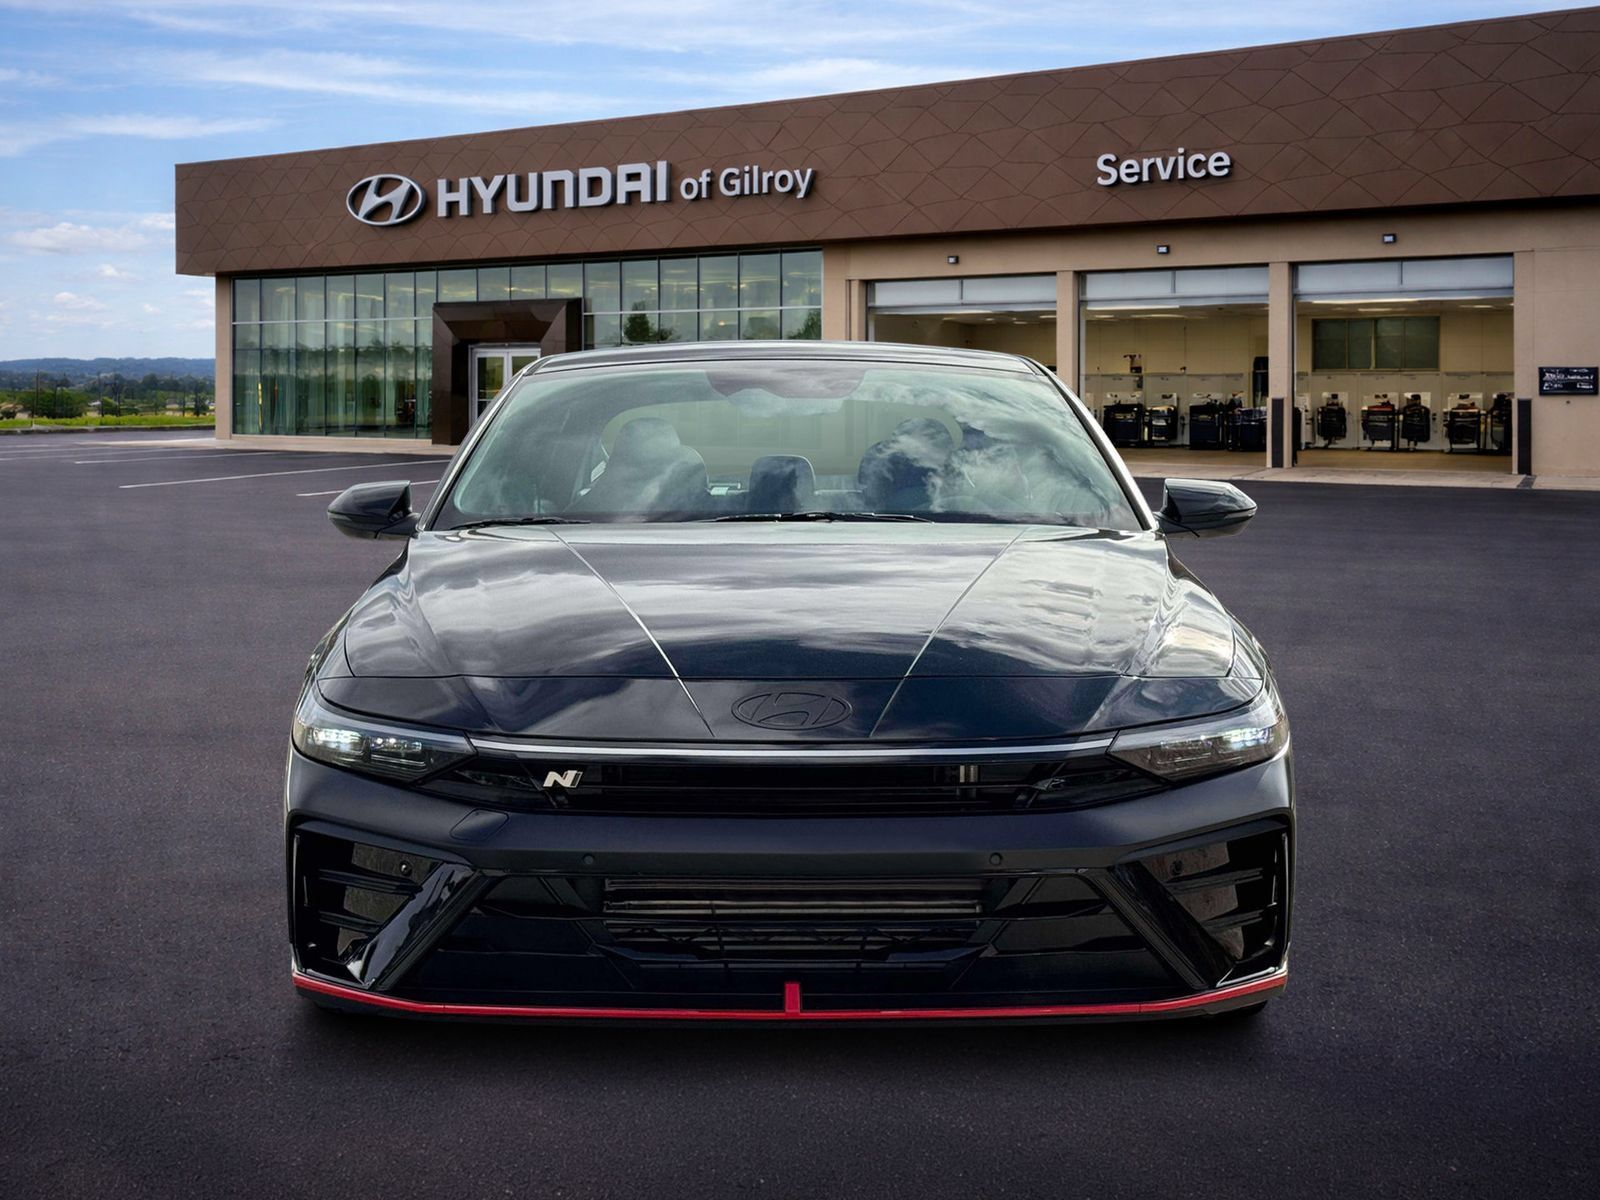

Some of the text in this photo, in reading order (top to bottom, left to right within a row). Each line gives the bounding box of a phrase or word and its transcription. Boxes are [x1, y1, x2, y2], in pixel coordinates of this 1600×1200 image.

[436, 160, 668, 218] HYUNDAI
[679, 170, 712, 201] of
[718, 164, 814, 199] Gilroy
[1096, 147, 1232, 186] Service
